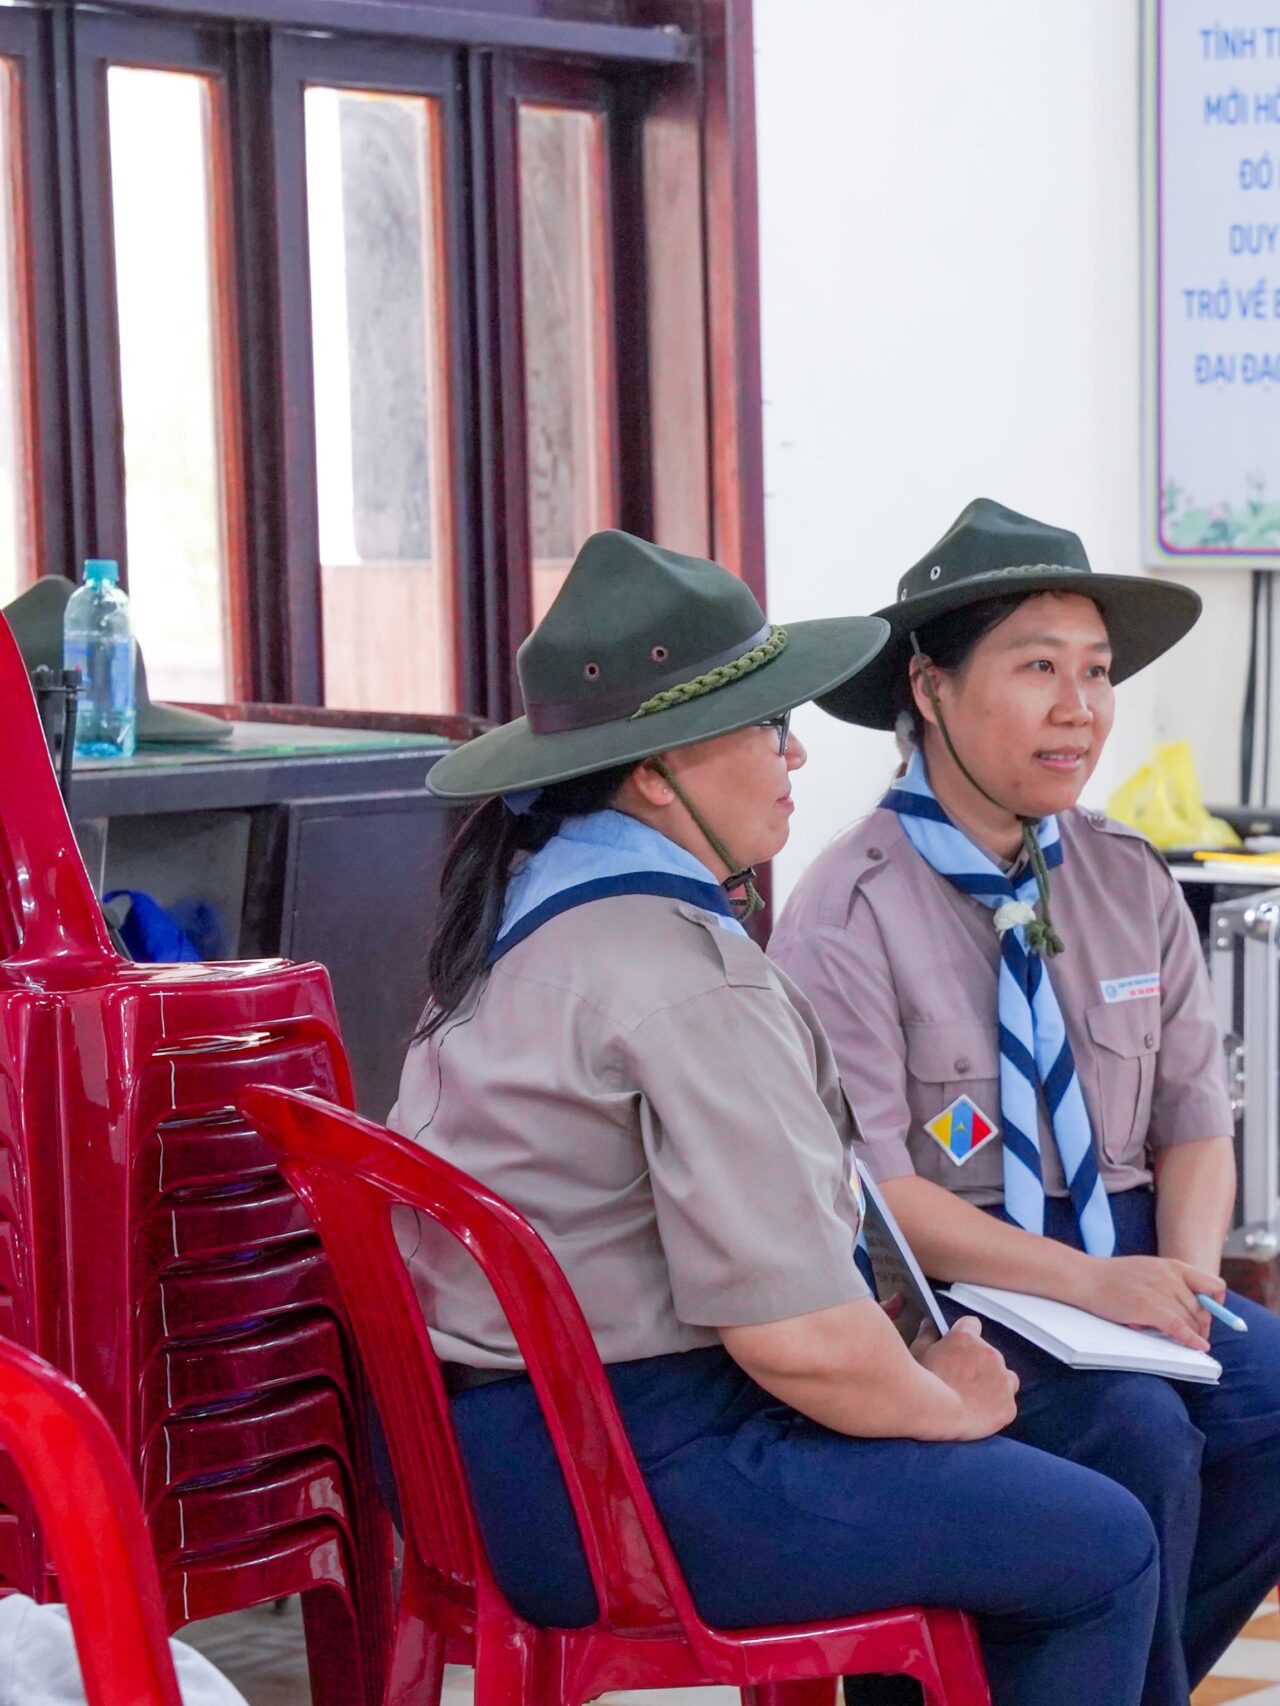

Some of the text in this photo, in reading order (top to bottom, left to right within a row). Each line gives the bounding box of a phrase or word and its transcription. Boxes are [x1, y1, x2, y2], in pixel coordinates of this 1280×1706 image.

[1200, 20, 1256, 60] TÌNH
[1239, 151, 1272, 190] ĐÓ
[1229, 222, 1279, 255] DUY
[1183, 278, 1231, 320] TRỞ
[1236, 276, 1268, 319] VỀ
[1194, 352, 1237, 392] ĐẠI
